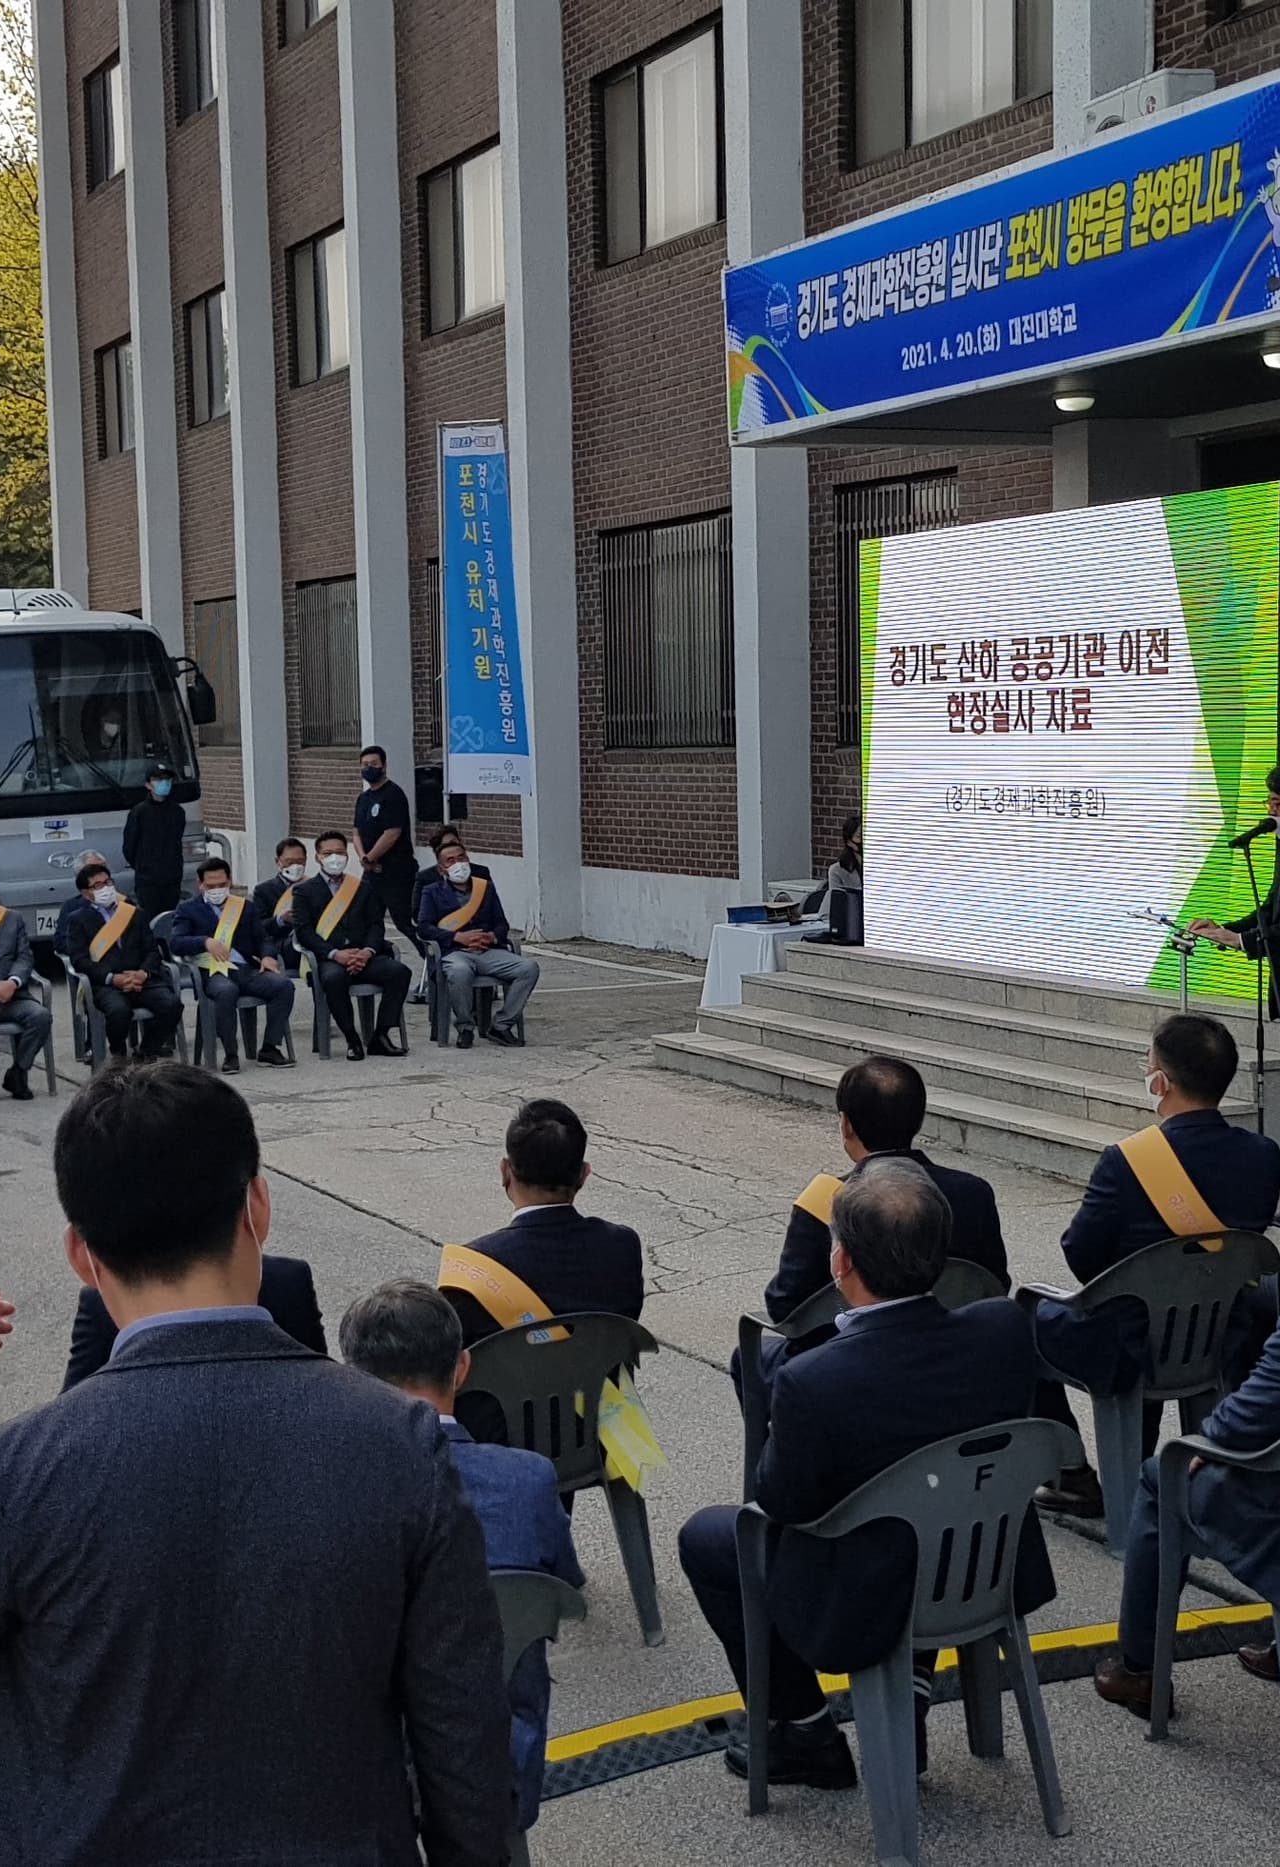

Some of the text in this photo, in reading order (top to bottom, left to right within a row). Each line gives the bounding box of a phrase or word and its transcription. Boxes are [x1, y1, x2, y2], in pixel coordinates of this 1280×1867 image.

[796, 273, 839, 341] 경기도
[841, 237, 948, 328] 경제과학진흥원
[950, 221, 1004, 299] 실사단
[1005, 201, 1063, 281] 포천시
[1066, 181, 1127, 266] 방문을
[1129, 141, 1245, 249] 환영합니다.
[901, 303, 1078, 371] 2021. 4. 20.(화) 대진대학교
[458, 463, 478, 546] 포천시
[465, 559, 486, 614] 유치
[477, 462, 517, 743] 경기도경제과학진흥원
[471, 626, 492, 681] 기원
[889, 627, 1170, 687] 경기도 산하 공공기관 이전
[947, 687, 1093, 735] 현장실사 자료
[945, 785, 1106, 819] (경기도경제과학진흥원)
[975, 1463, 995, 1490] F
